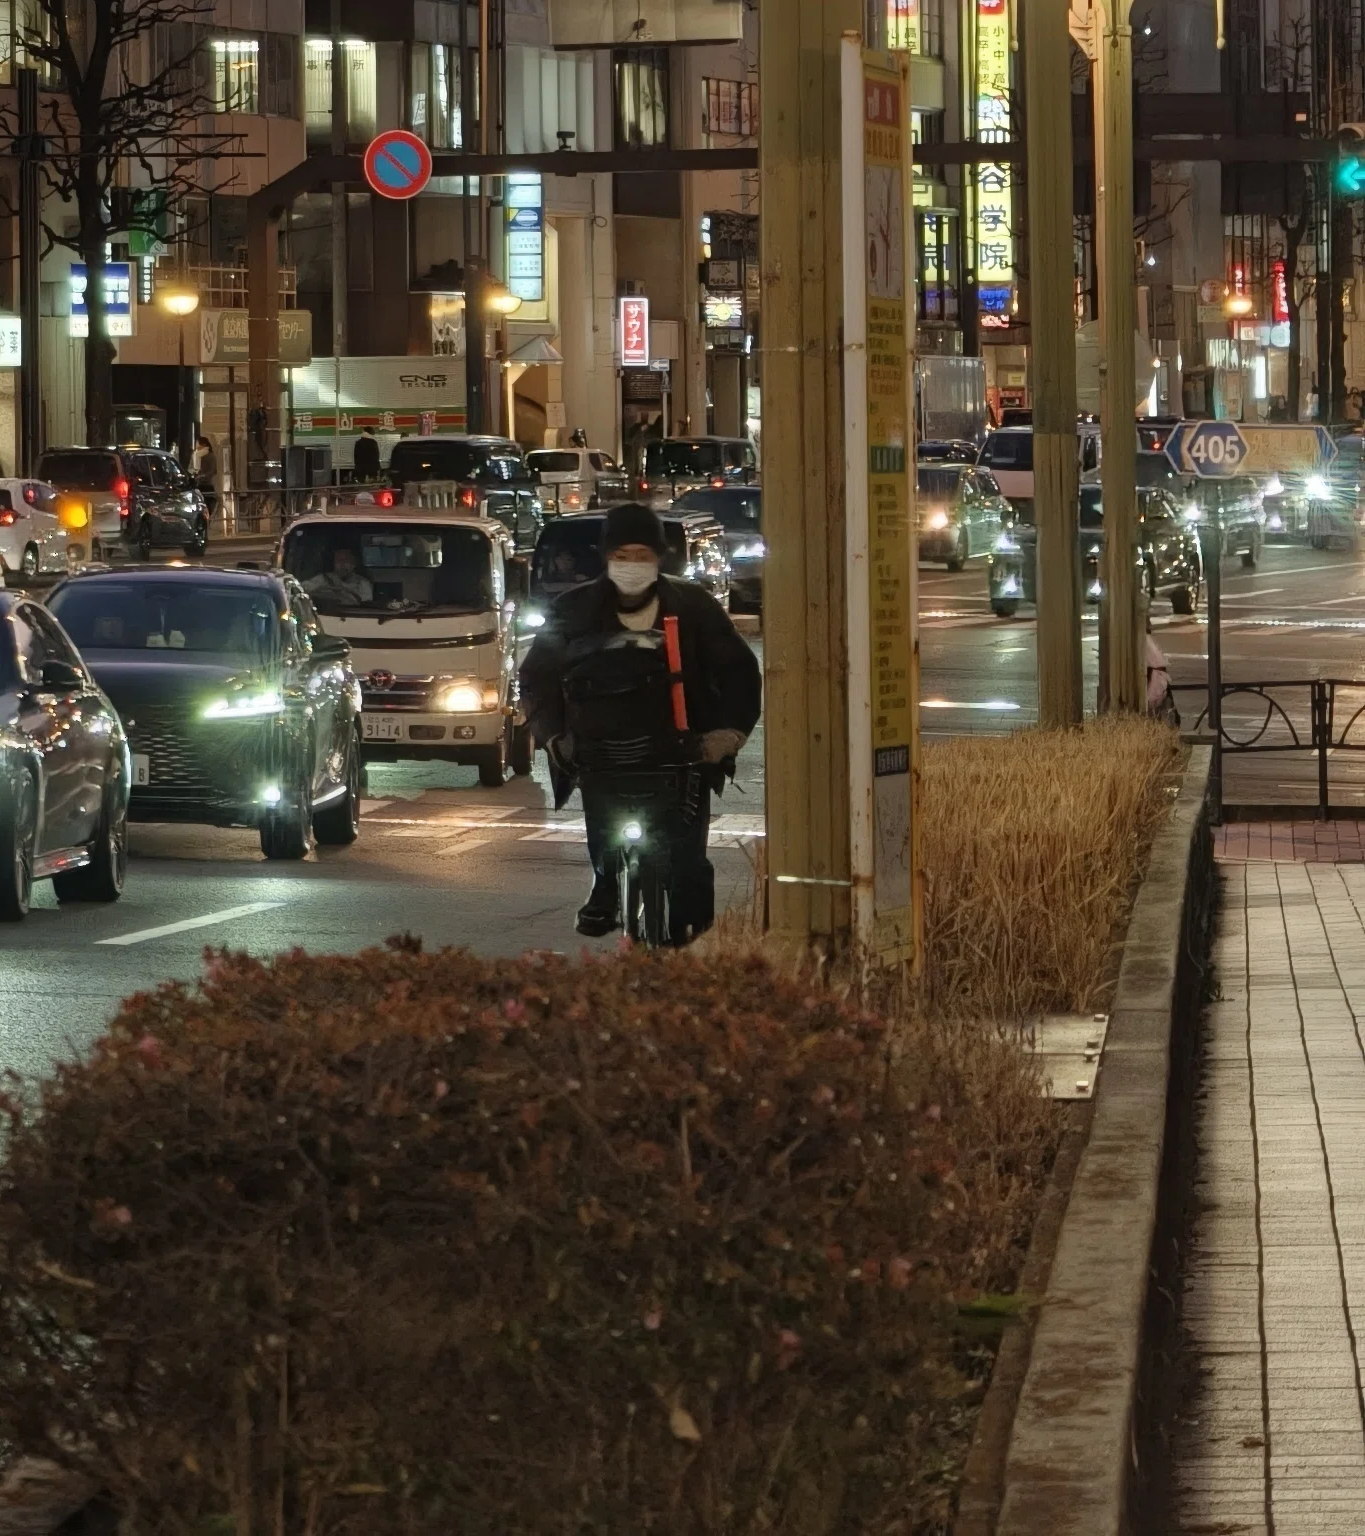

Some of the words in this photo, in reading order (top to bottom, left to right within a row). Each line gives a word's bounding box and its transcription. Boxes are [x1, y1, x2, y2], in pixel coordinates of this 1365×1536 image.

[627, 304, 642, 350] サウナ
[399, 374, 448, 383] CNG
[1191, 434, 1241, 464] 405
